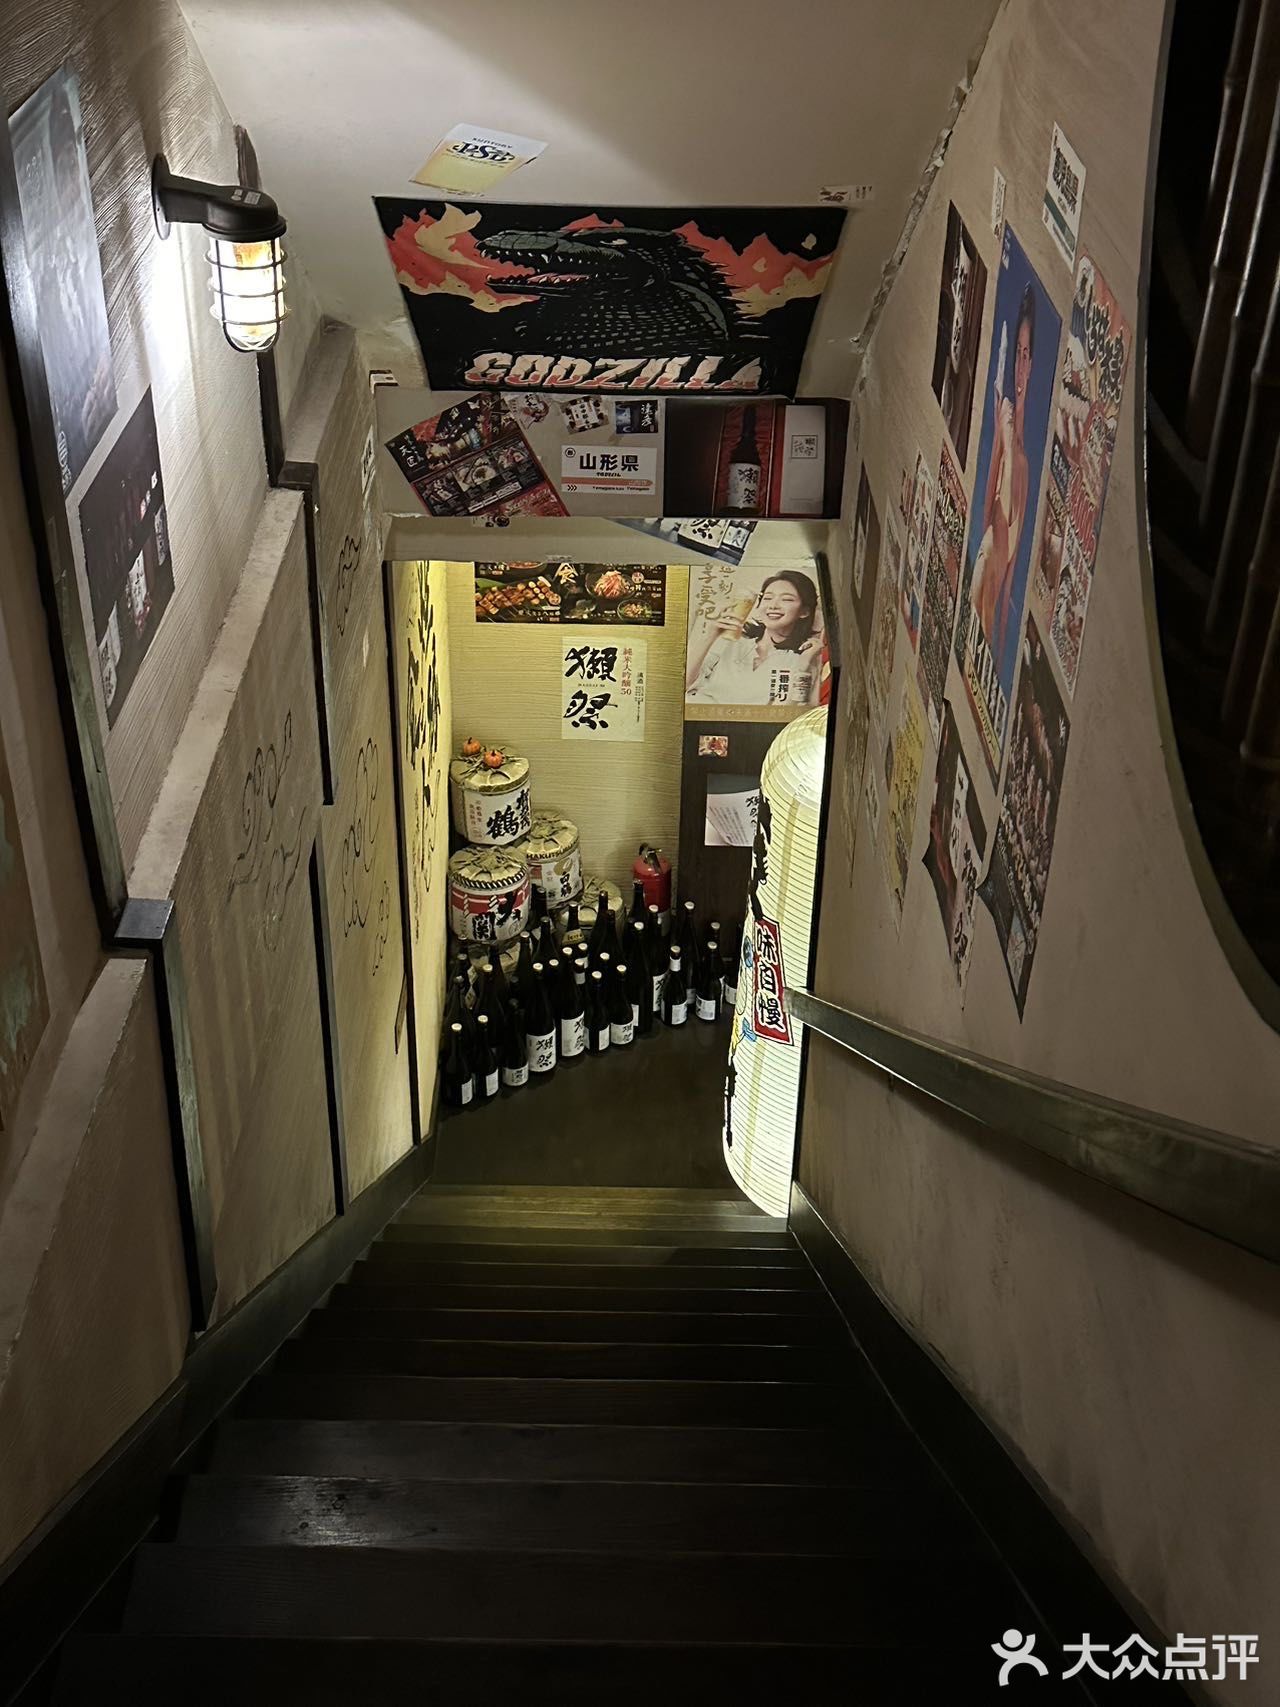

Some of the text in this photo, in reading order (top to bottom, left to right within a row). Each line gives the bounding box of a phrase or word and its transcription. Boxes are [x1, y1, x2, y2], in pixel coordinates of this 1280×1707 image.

[464, 352, 763, 390] GODZILLA
[580, 453, 640, 472] 山形県
[563, 646, 618, 730] 獺祭
